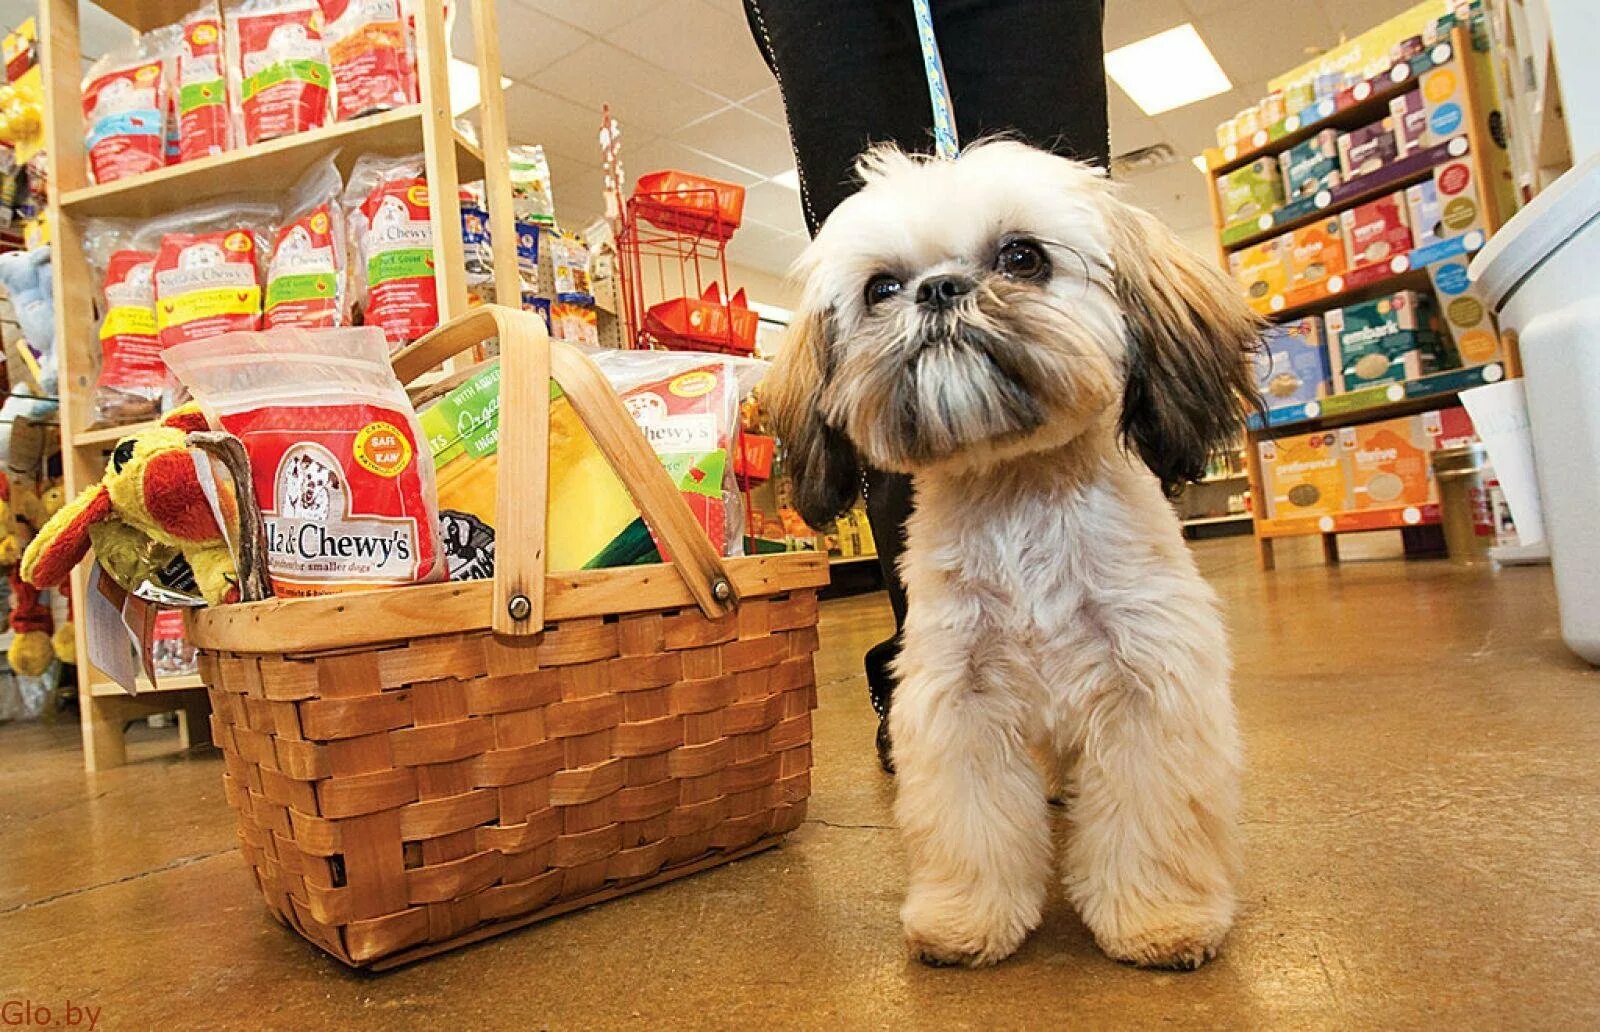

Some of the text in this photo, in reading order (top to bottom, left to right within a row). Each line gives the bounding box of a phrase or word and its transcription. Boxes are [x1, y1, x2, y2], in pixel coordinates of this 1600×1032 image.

[452, 386, 476, 406] WITH
[457, 396, 500, 440] Orga
[298, 522, 410, 568] Chewy's
